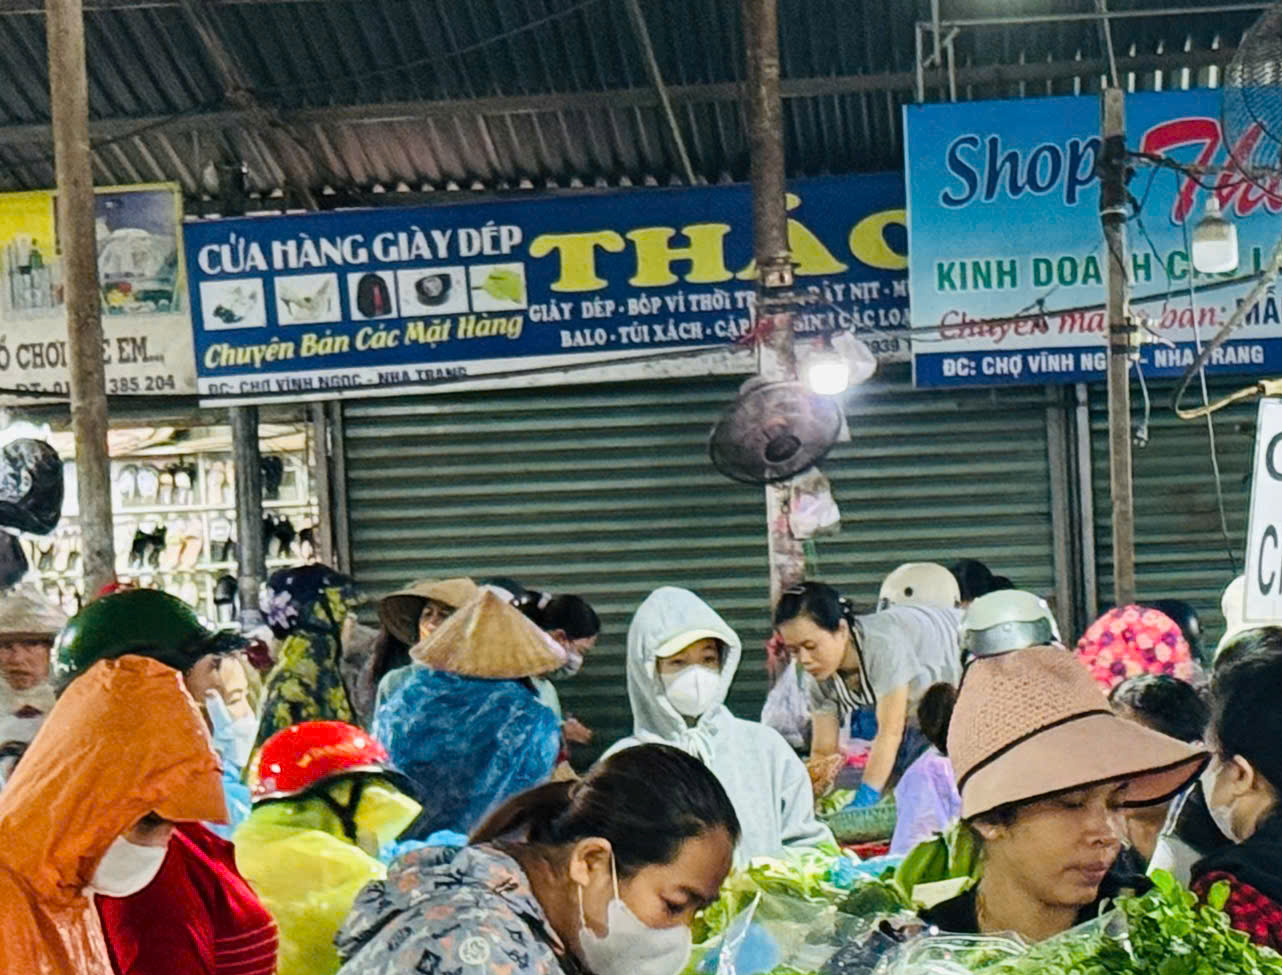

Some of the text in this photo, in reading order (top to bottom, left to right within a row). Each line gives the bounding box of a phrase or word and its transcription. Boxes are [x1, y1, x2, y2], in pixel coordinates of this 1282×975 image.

[941, 134, 1101, 208] Shop
[198, 220, 523, 275] CỬA HÀNG GIÀY DÉP
[936, 259, 1017, 291] KINH
[1032, 251, 1152, 288] DOAH
[204, 336, 295, 369] Chuyên
[355, 323, 400, 351] Các
[404, 317, 451, 349] Mặt
[457, 313, 524, 339] Hàng
[560, 328, 607, 347] BALO
[653, 319, 703, 342] XÁCH
[943, 358, 977, 377] ĐC:
[982, 354, 1022, 378] CHỢ
[1027, 351, 1074, 373] VĨNH
[1154, 348, 1194, 368] NHA
[1204, 345, 1264, 365] RANG
[110, 375, 175, 393] 385 204
